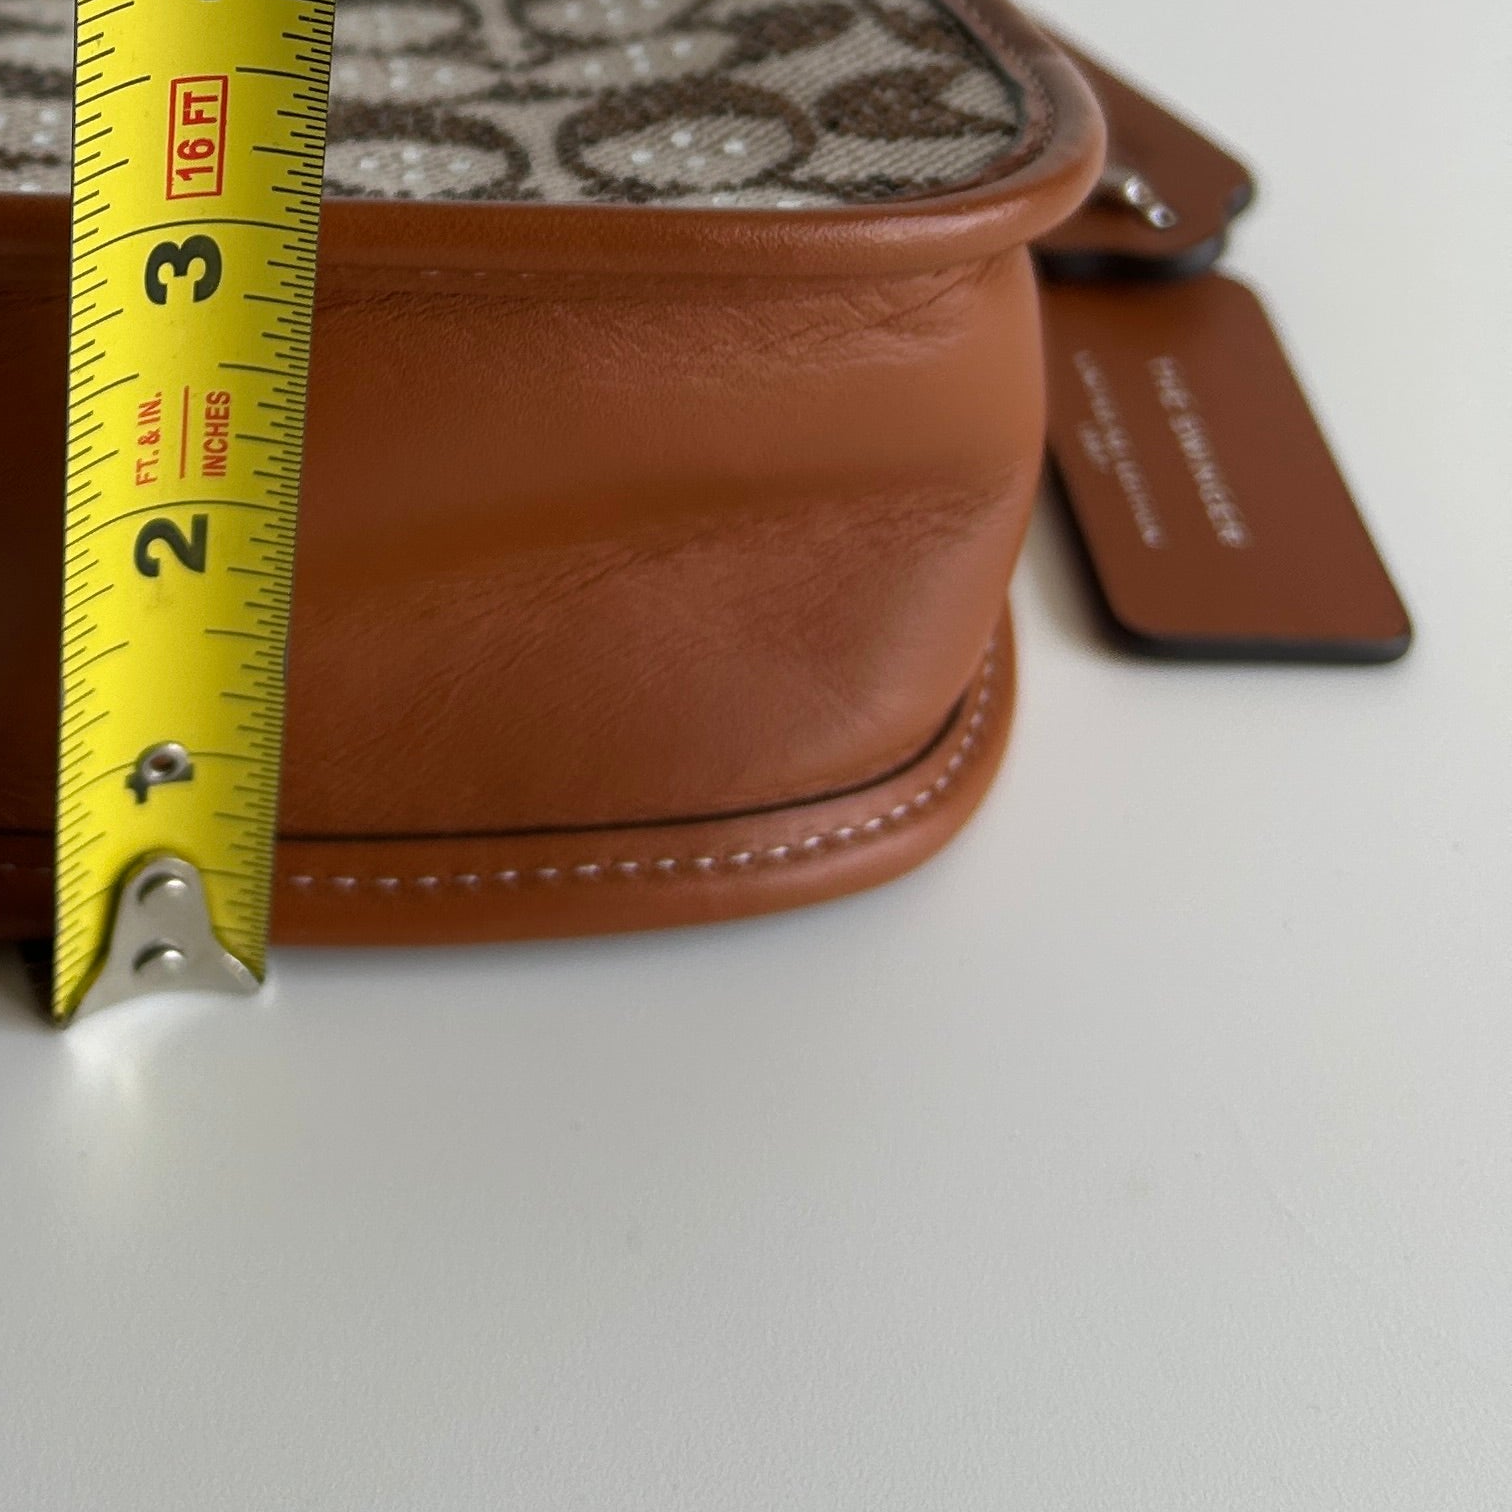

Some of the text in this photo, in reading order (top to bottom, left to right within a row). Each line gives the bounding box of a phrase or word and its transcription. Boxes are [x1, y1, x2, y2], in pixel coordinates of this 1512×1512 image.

[176, 90, 218, 181] 16 FT
[144, 234, 222, 305] 3
[136, 391, 162, 486] FT. & IN.
[202, 391, 231, 477] INCHES
[134, 514, 209, 578] 2
